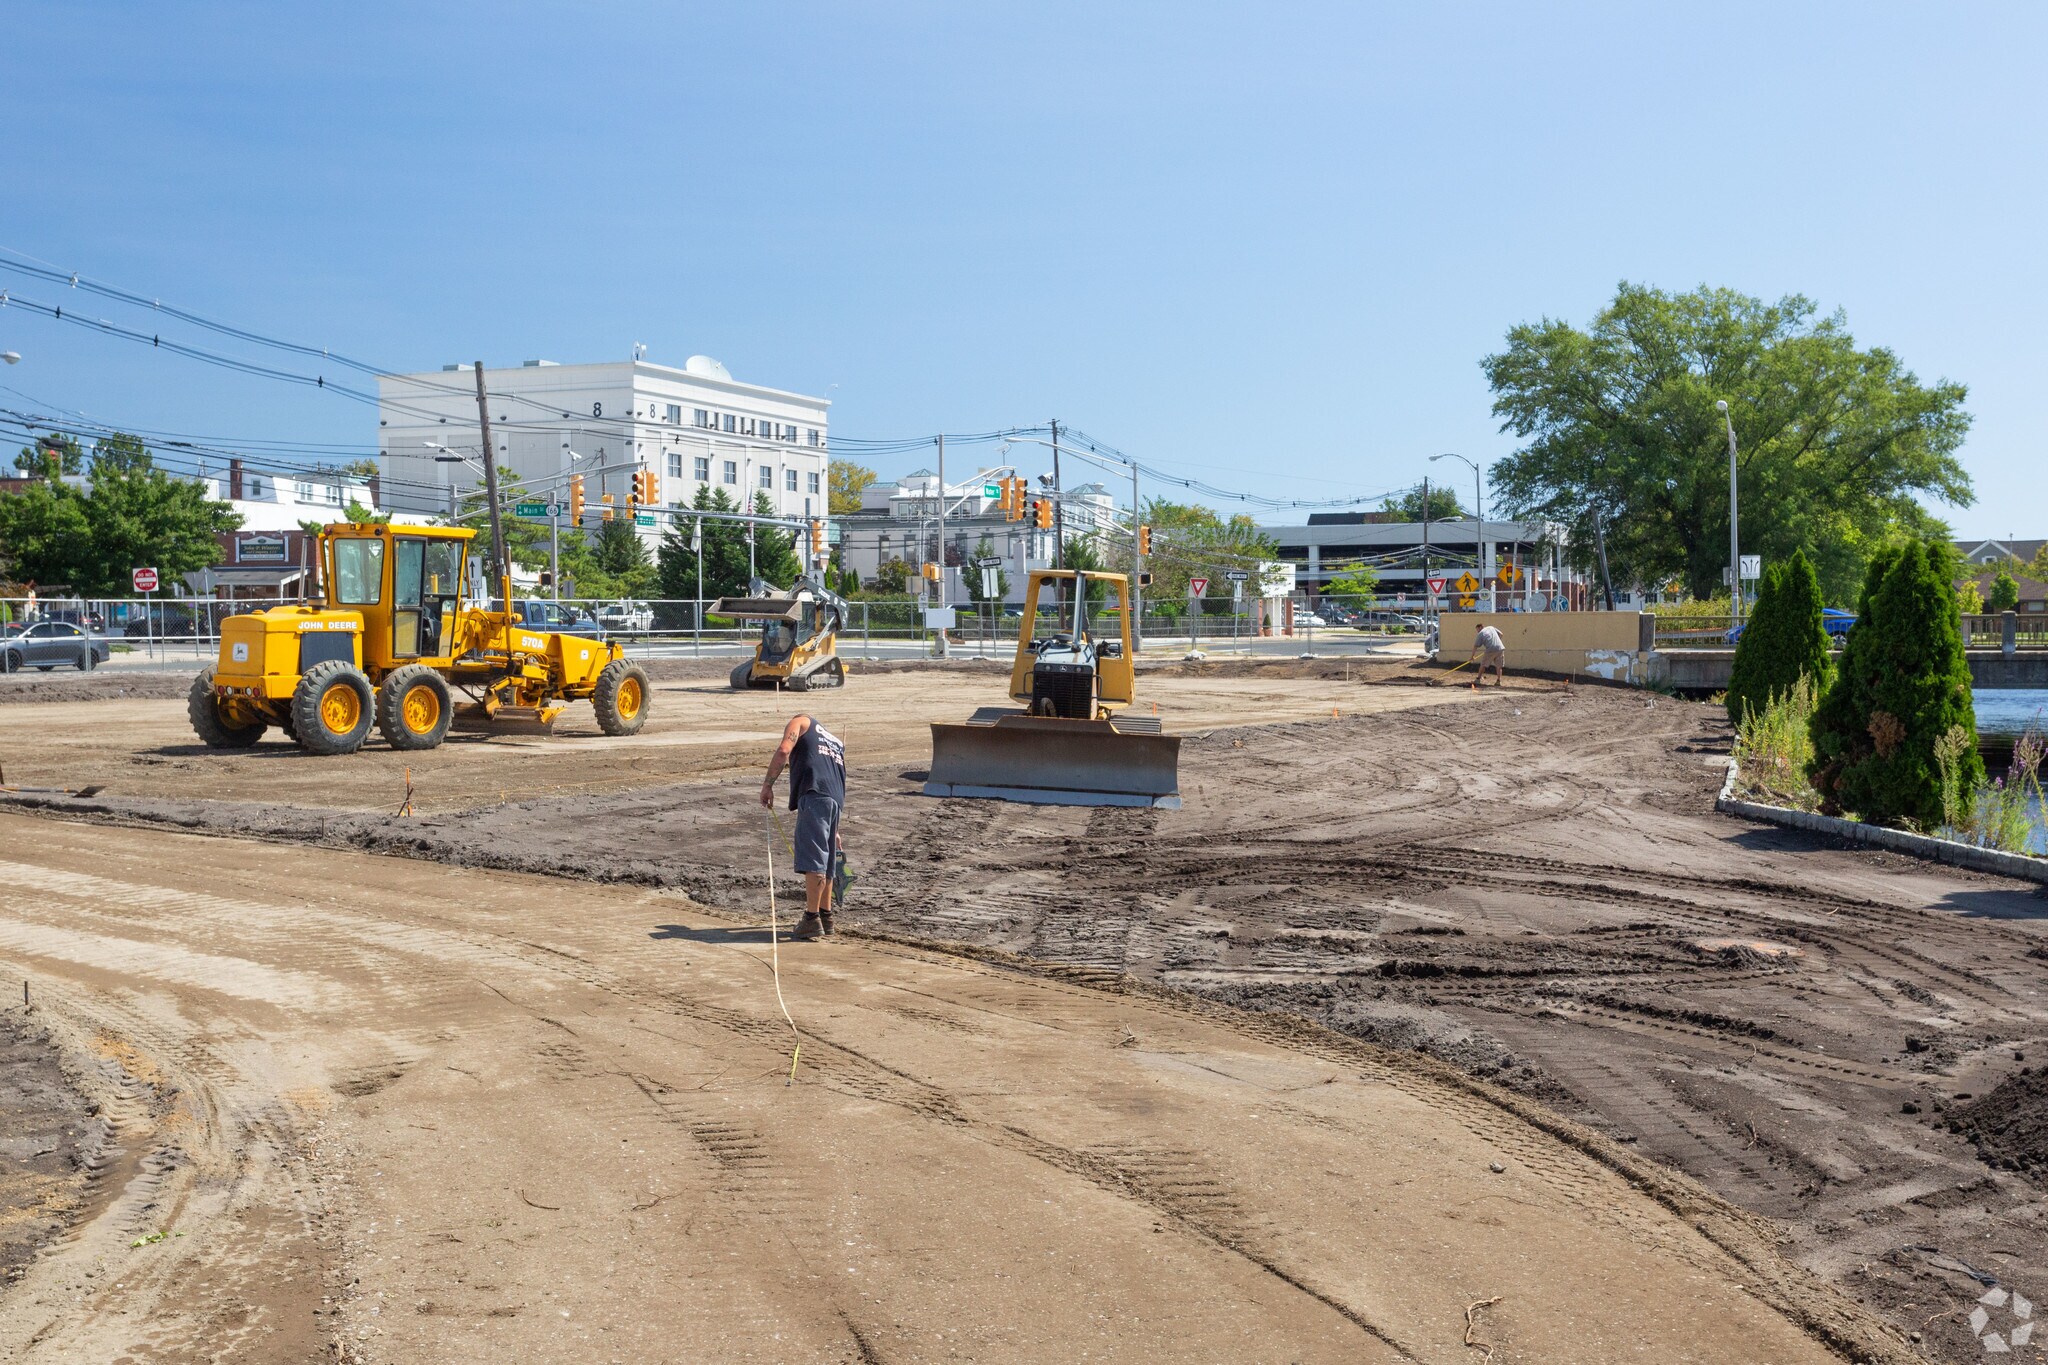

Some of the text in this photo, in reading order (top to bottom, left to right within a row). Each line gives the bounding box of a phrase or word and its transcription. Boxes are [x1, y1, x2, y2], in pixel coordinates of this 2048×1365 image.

[593, 402, 602, 417] 8
[650, 403, 655, 418] 8
[523, 506, 538, 514] Main
[547, 507, 557, 515] 166
[470, 579, 480, 587] NLY
[298, 621, 357, 629] JOHN DEERE
[521, 636, 544, 649] 570A
